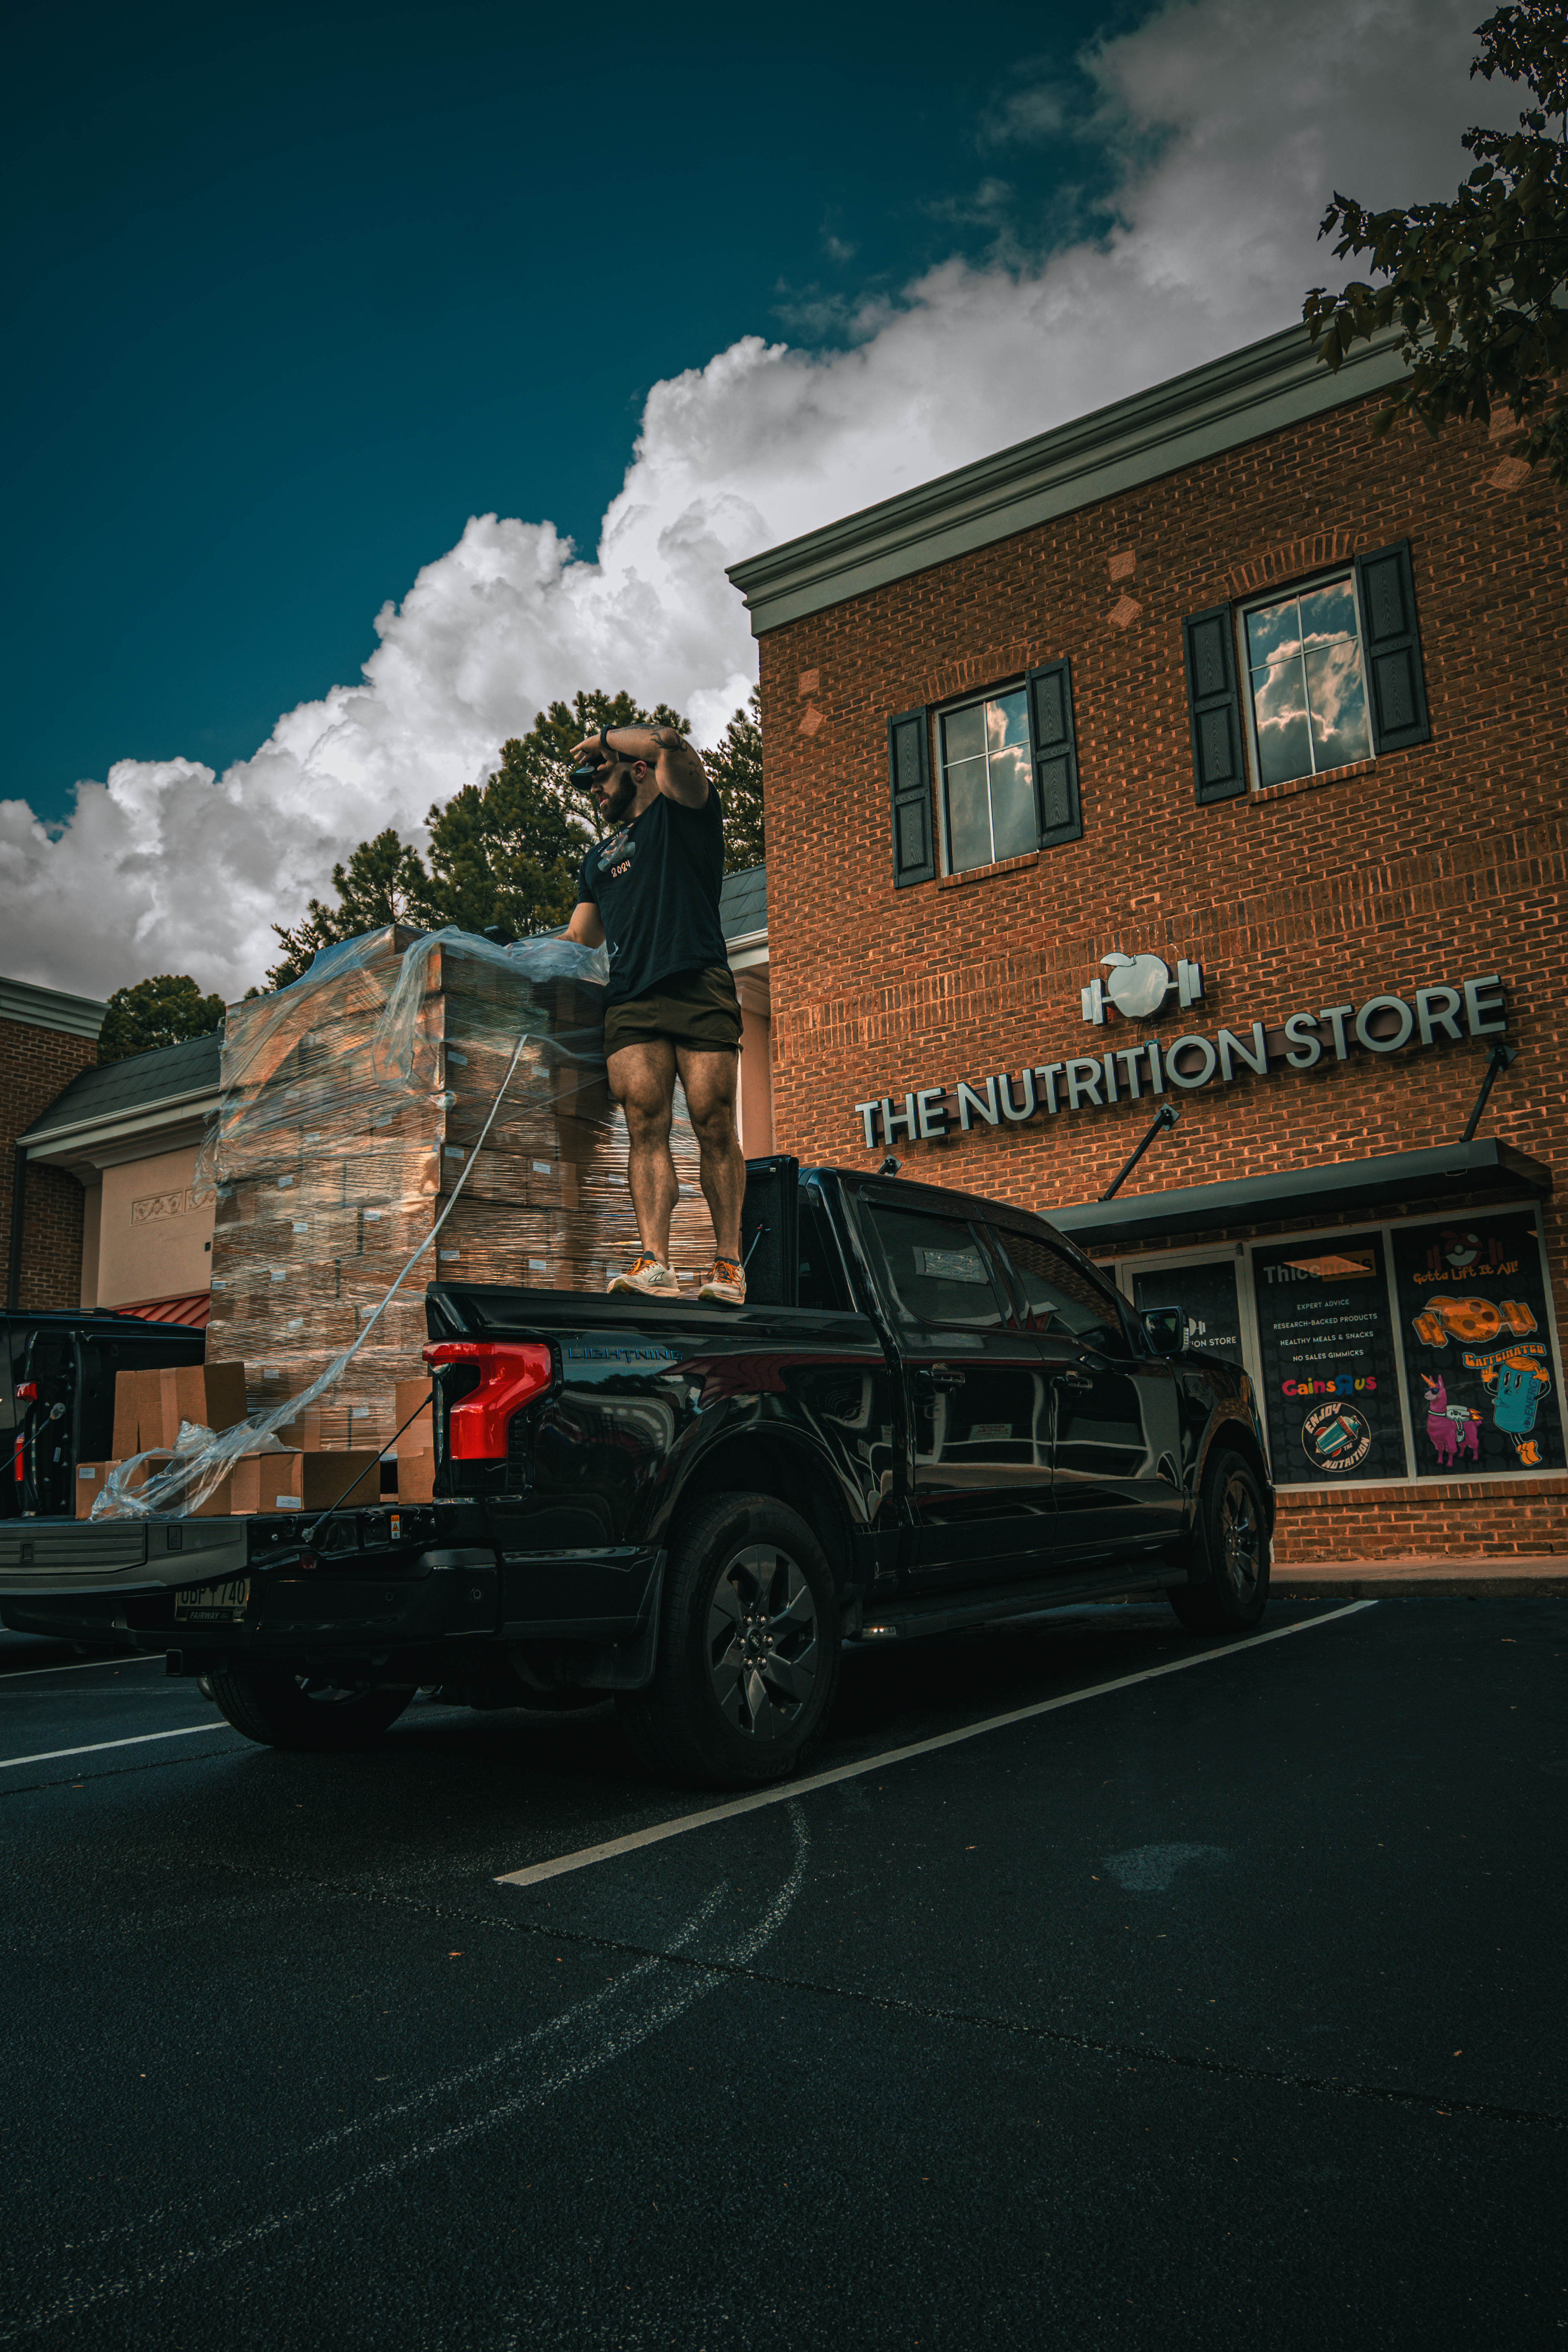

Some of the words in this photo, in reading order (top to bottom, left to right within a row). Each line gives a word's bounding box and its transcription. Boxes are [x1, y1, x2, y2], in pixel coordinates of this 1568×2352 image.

[611, 859, 631, 878] 2024
[855, 1087, 950, 1148] THE
[957, 1022, 1270, 1130] NUTRITION
[1285, 975, 1507, 1069] STORE
[1413, 1269, 1448, 1285] Gotta
[1451, 1266, 1476, 1280] Lift
[1478, 1264, 1494, 1275] It
[1497, 1260, 1518, 1275] All!
[1325, 1299, 1349, 1307] ADVICE
[1273, 1318, 1338, 1329] RESEARCH-BACKED
[1340, 1313, 1377, 1323] PRODUCTS
[1209, 1336, 1237, 1346] STORE
[1280, 1337, 1310, 1346] HEALTHY
[1345, 1331, 1374, 1339] SNACKS
[569, 1348, 683, 1363] LIGHTNING
[1328, 1350, 1364, 1358] GIMMICKS
[1305, 1403, 1342, 1434] ENJOY
[1321, 1437, 1370, 1469] NUTRITION
[1343, 1443, 1353, 1451] THE
